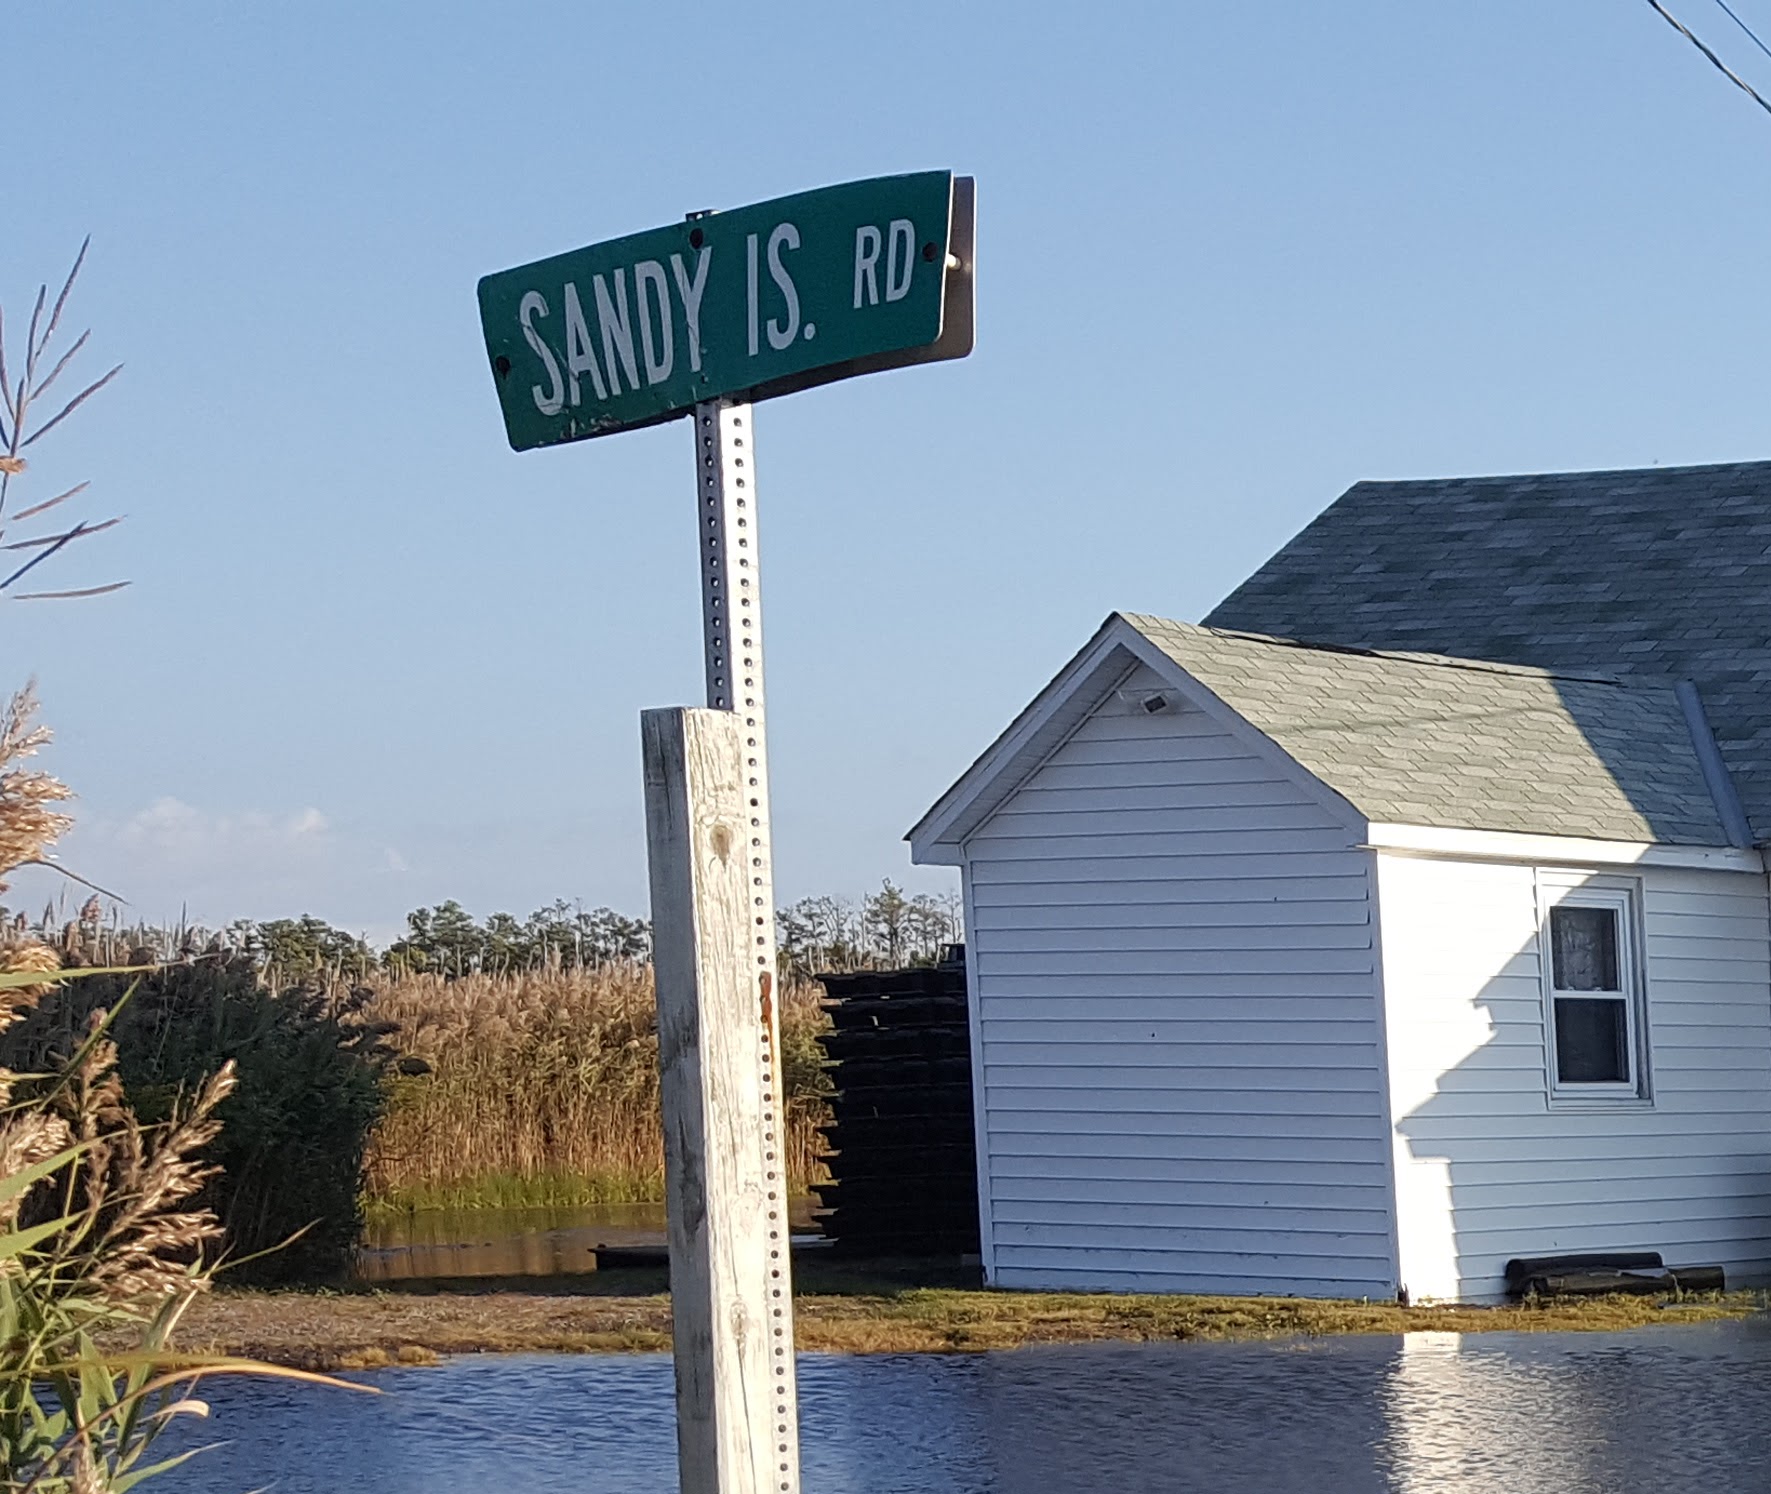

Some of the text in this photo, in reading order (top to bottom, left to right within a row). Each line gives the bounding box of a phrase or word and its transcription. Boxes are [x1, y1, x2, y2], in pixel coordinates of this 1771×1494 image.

[519, 219, 916, 416] SANDY IS. RD
